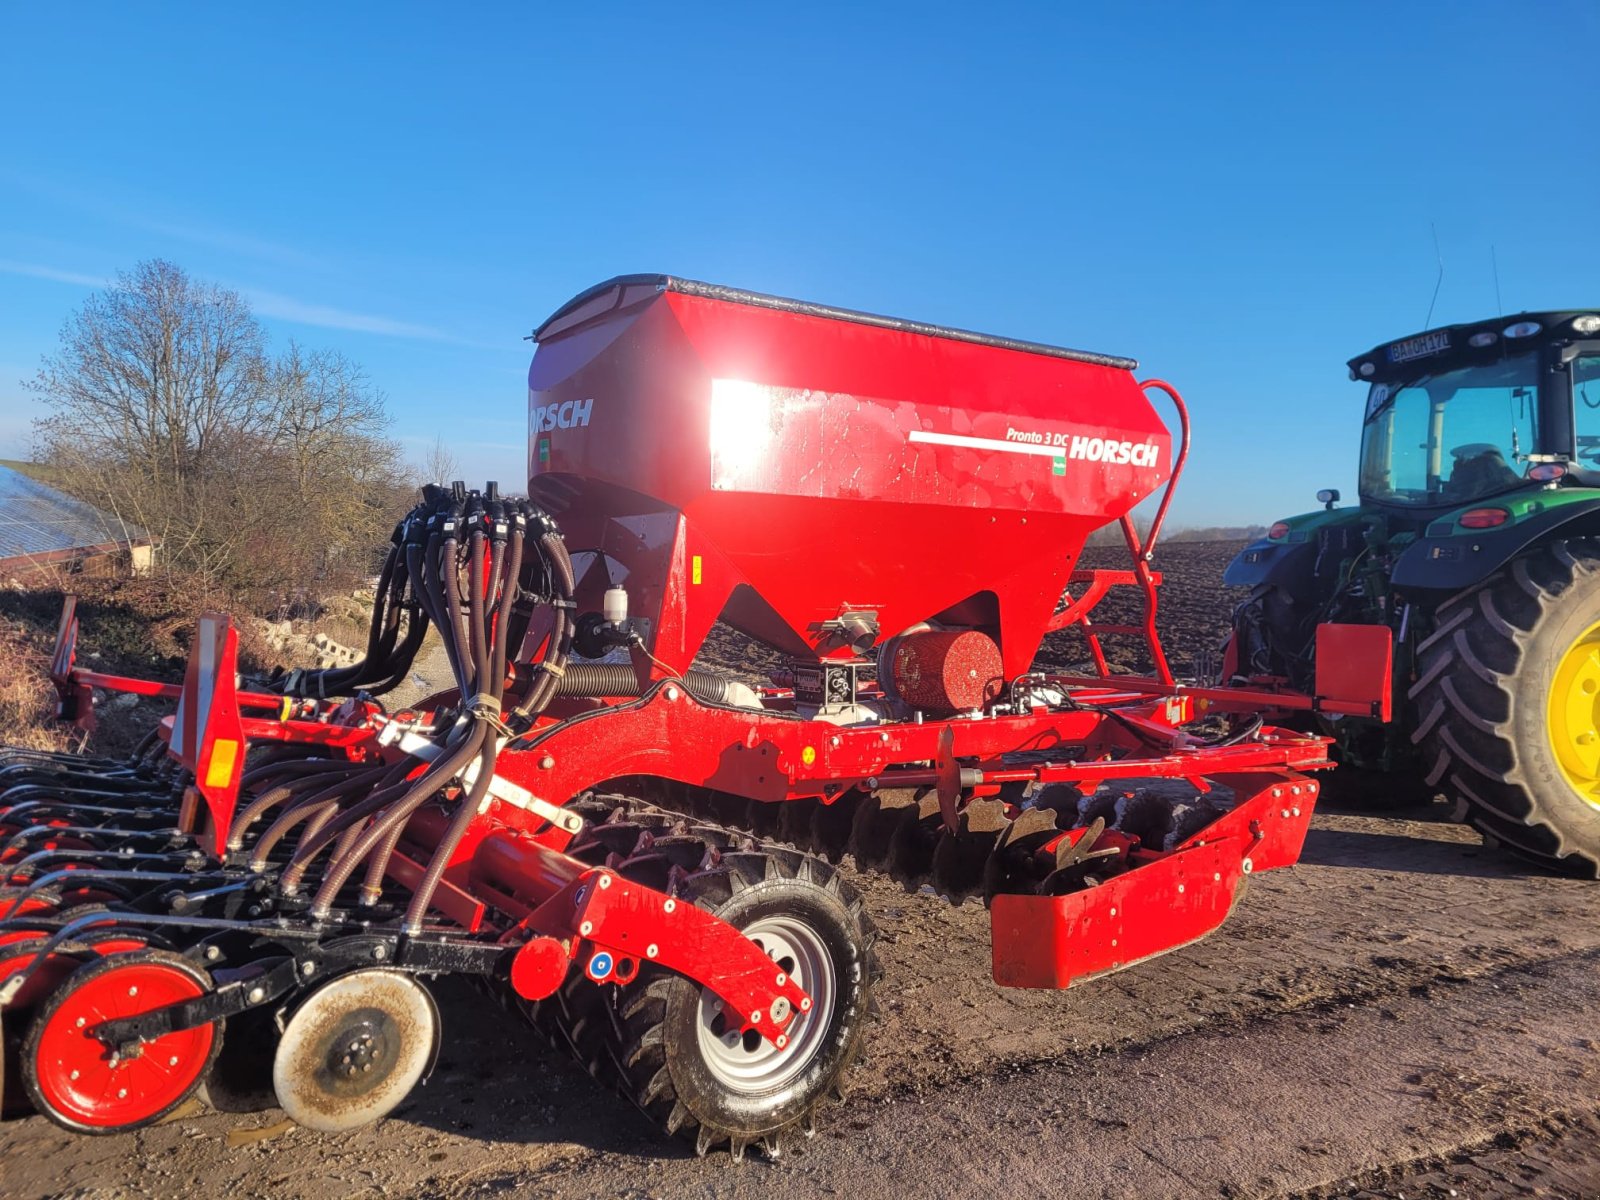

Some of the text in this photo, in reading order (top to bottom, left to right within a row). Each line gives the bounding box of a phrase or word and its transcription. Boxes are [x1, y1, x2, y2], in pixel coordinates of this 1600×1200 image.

[1006, 427, 1070, 447] Pronto 3 DC
[1069, 435, 1160, 468] HORSCH
